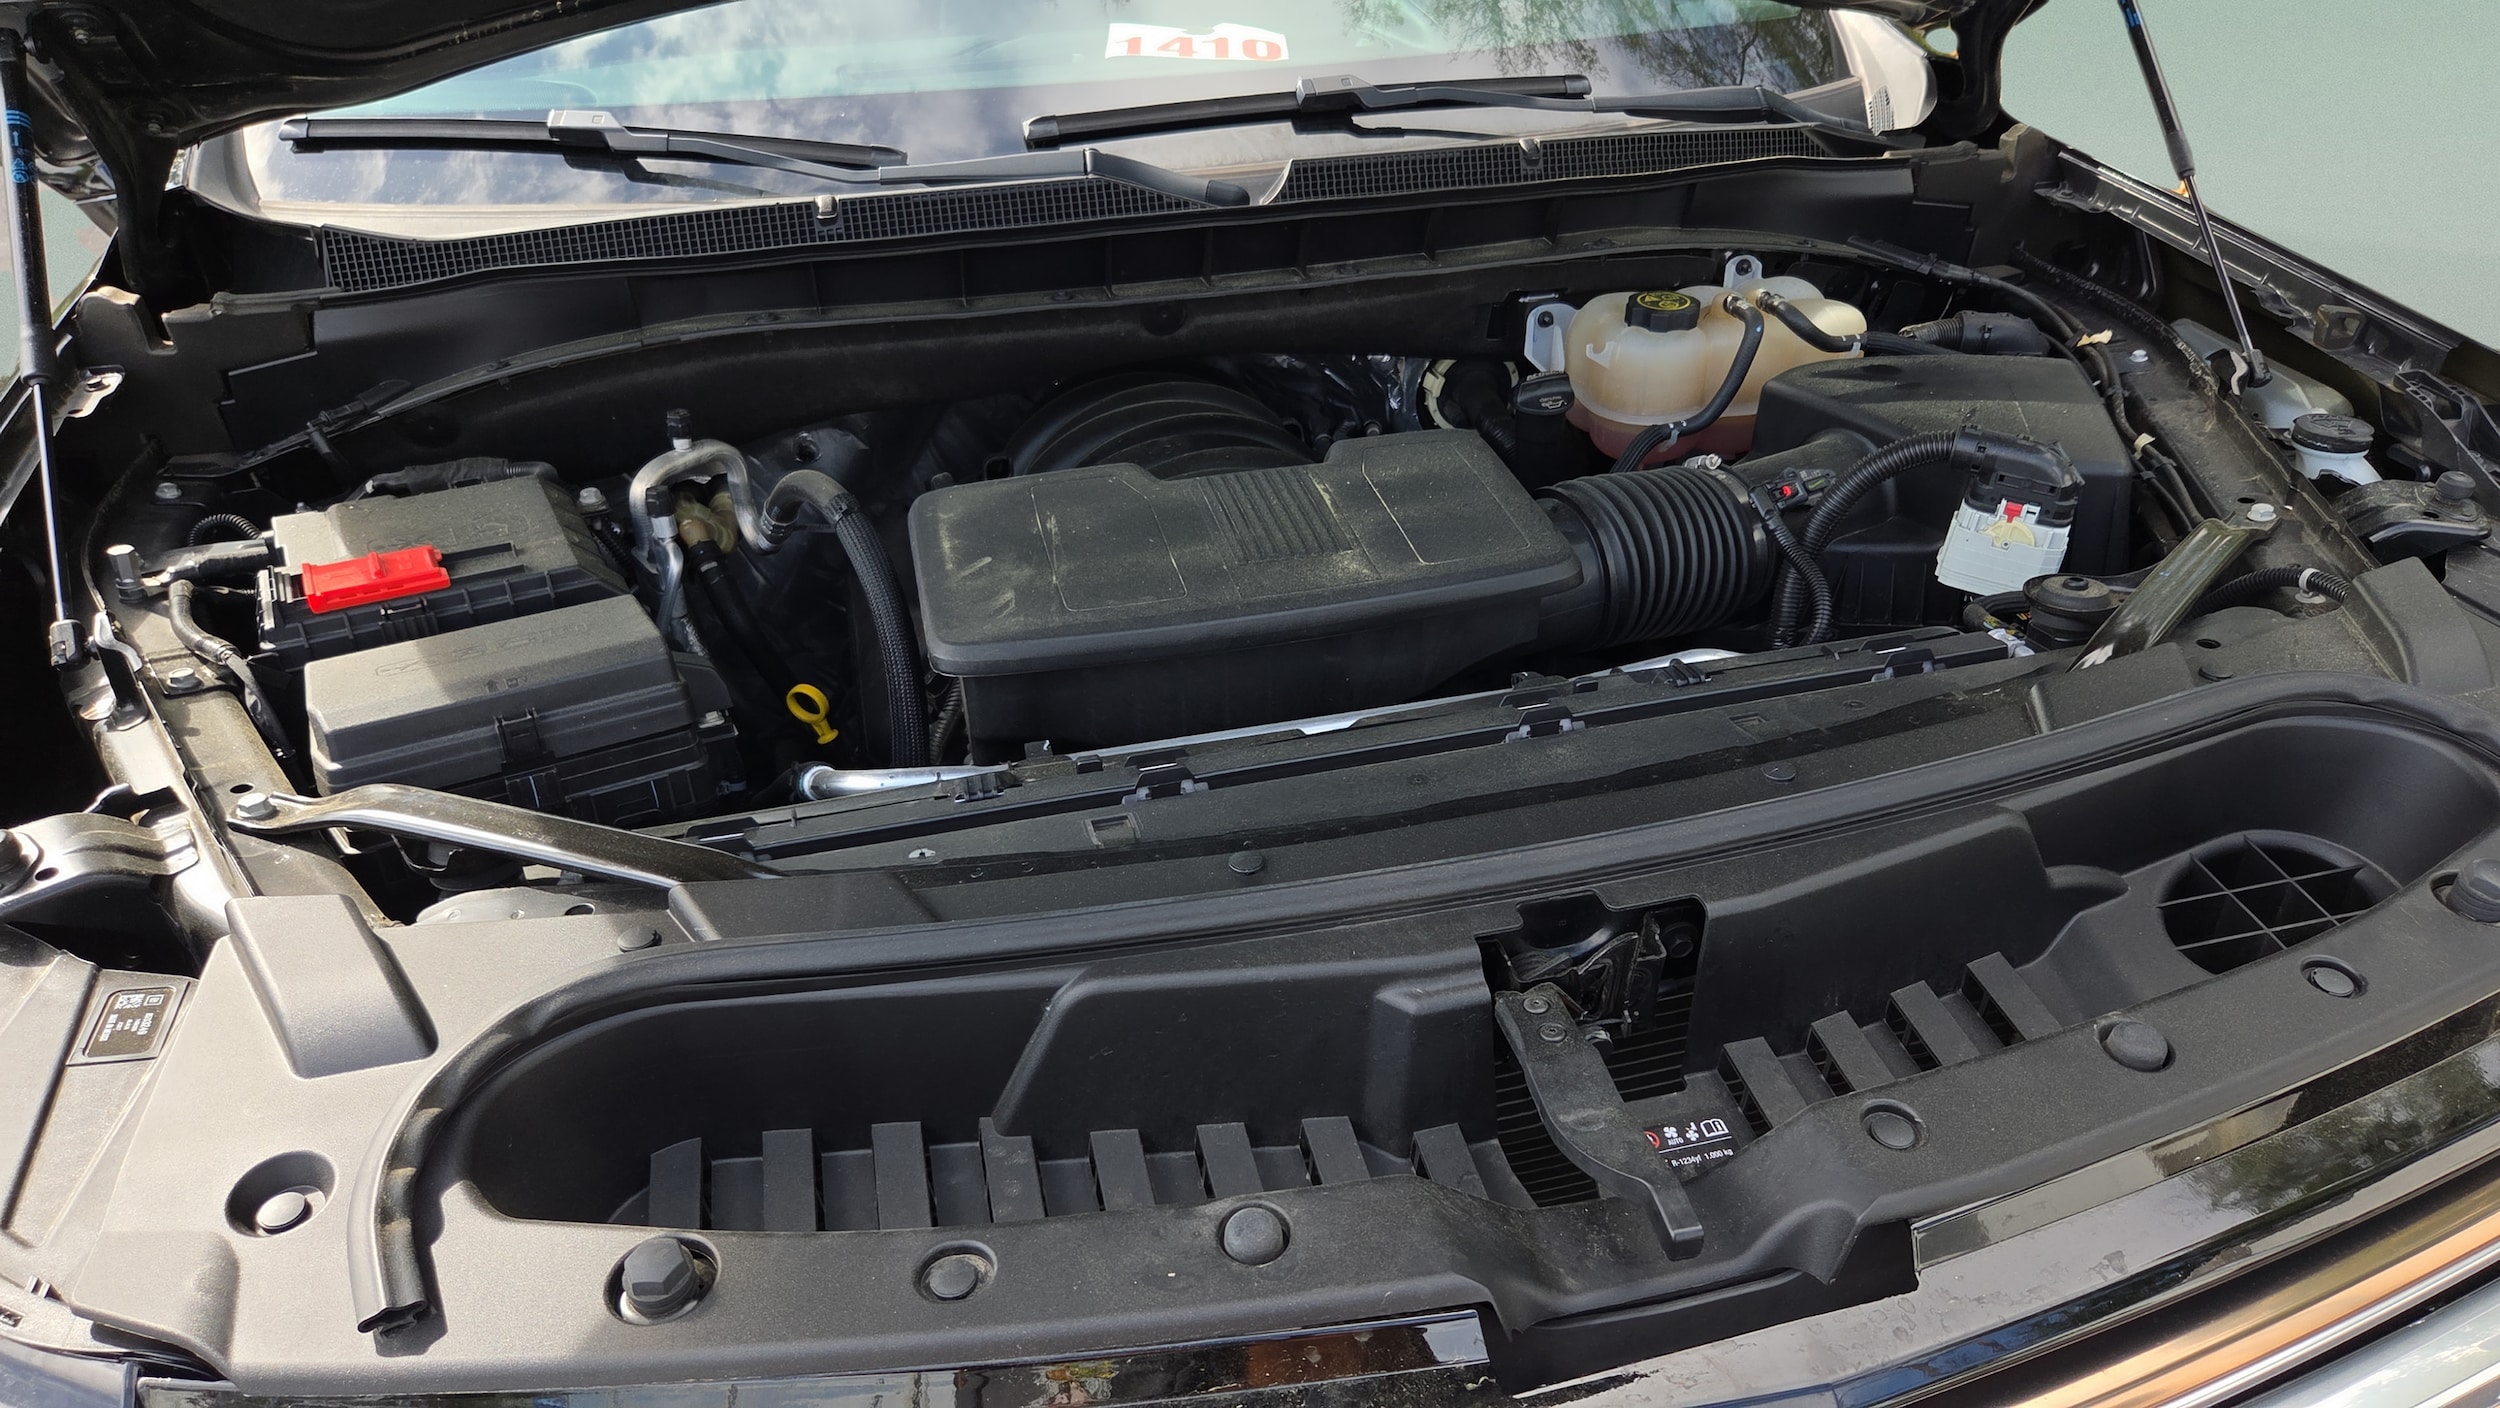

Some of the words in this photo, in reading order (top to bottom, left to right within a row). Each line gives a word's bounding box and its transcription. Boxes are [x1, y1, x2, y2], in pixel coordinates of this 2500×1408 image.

[1115, 36, 1282, 61] 1410
[1667, 1137, 1684, 1146] AUTO
[1723, 1148, 1734, 1157] kg
